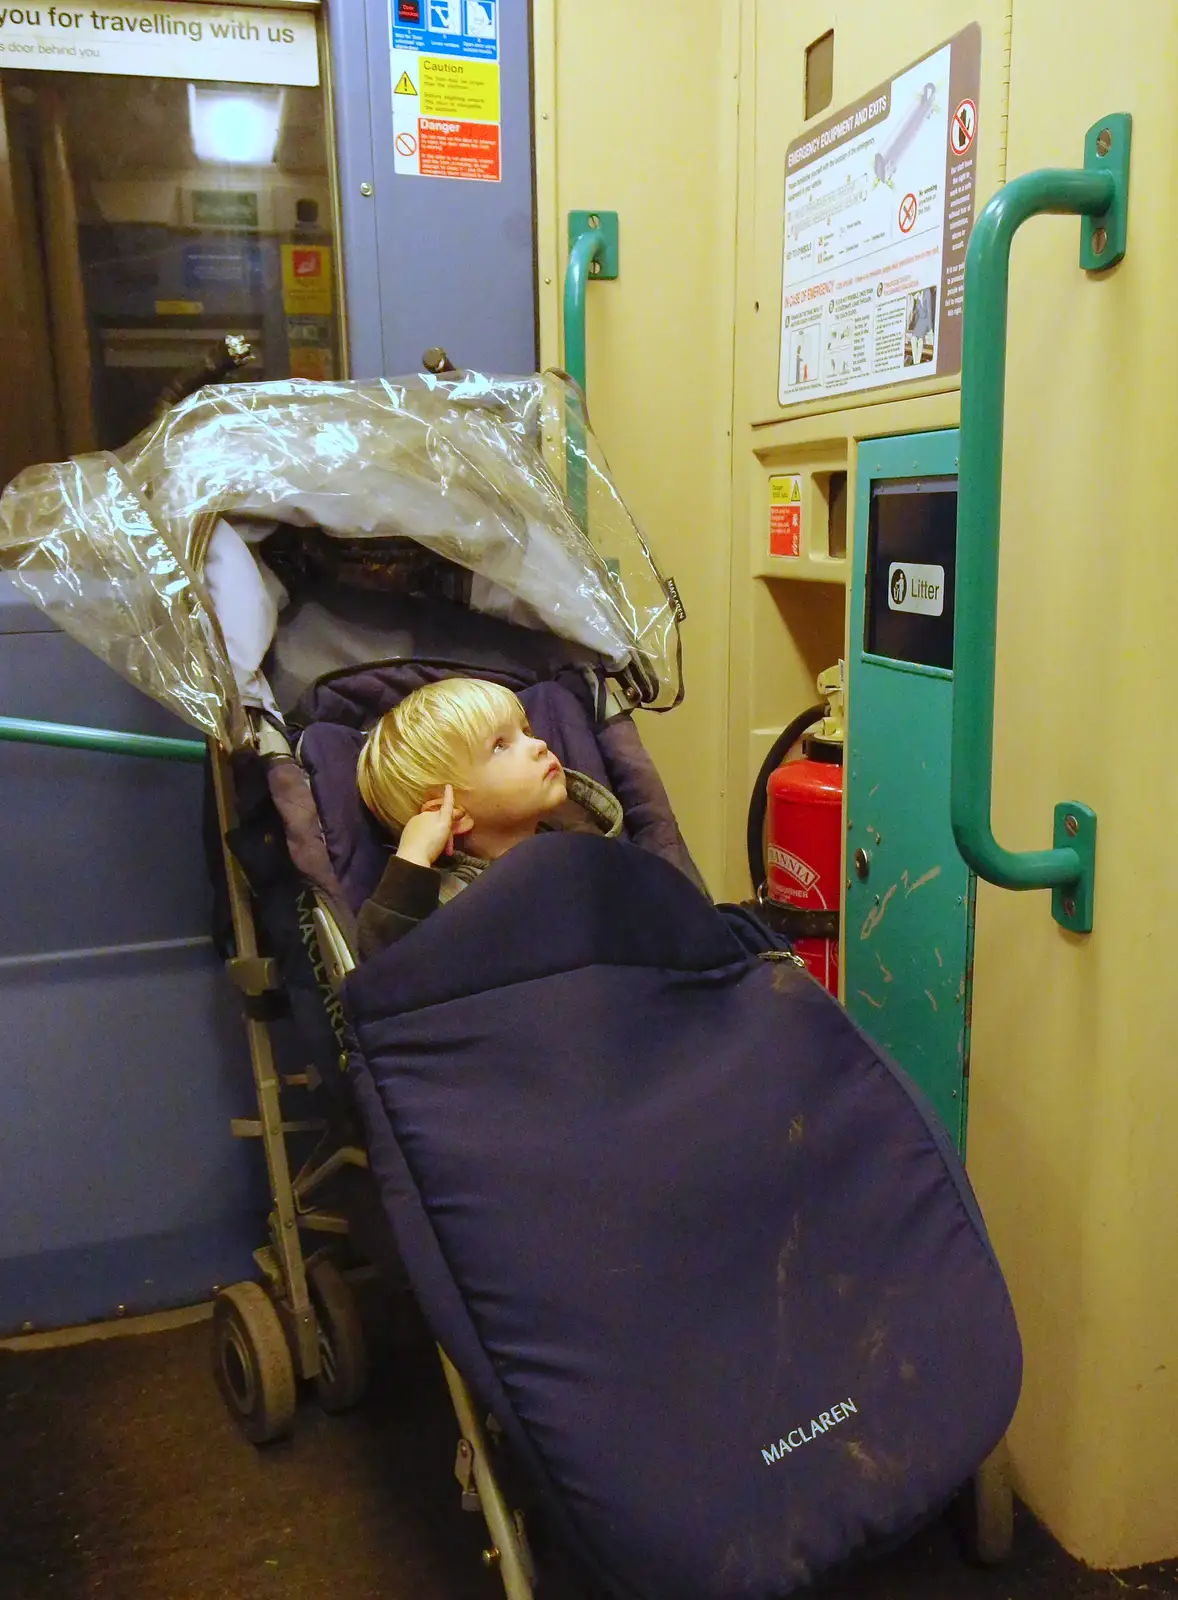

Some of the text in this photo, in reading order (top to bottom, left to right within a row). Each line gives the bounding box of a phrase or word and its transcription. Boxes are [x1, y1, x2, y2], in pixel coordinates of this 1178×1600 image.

[0, 7, 295, 43] you for travelling with us
[8, 41, 34, 53] door
[38, 42, 77, 56] behind
[423, 60, 464, 74] Caution
[420, 119, 460, 134] Danger
[788, 136, 820, 168] EMERGENCY
[820, 116, 854, 148] EQUIPMENT
[854, 107, 867, 128] AND
[868, 95, 887, 120] EXITS
[911, 578, 940, 600] Litter
[296, 889, 349, 1048] MACLARE
[761, 1397, 858, 1466] MACLAREN
